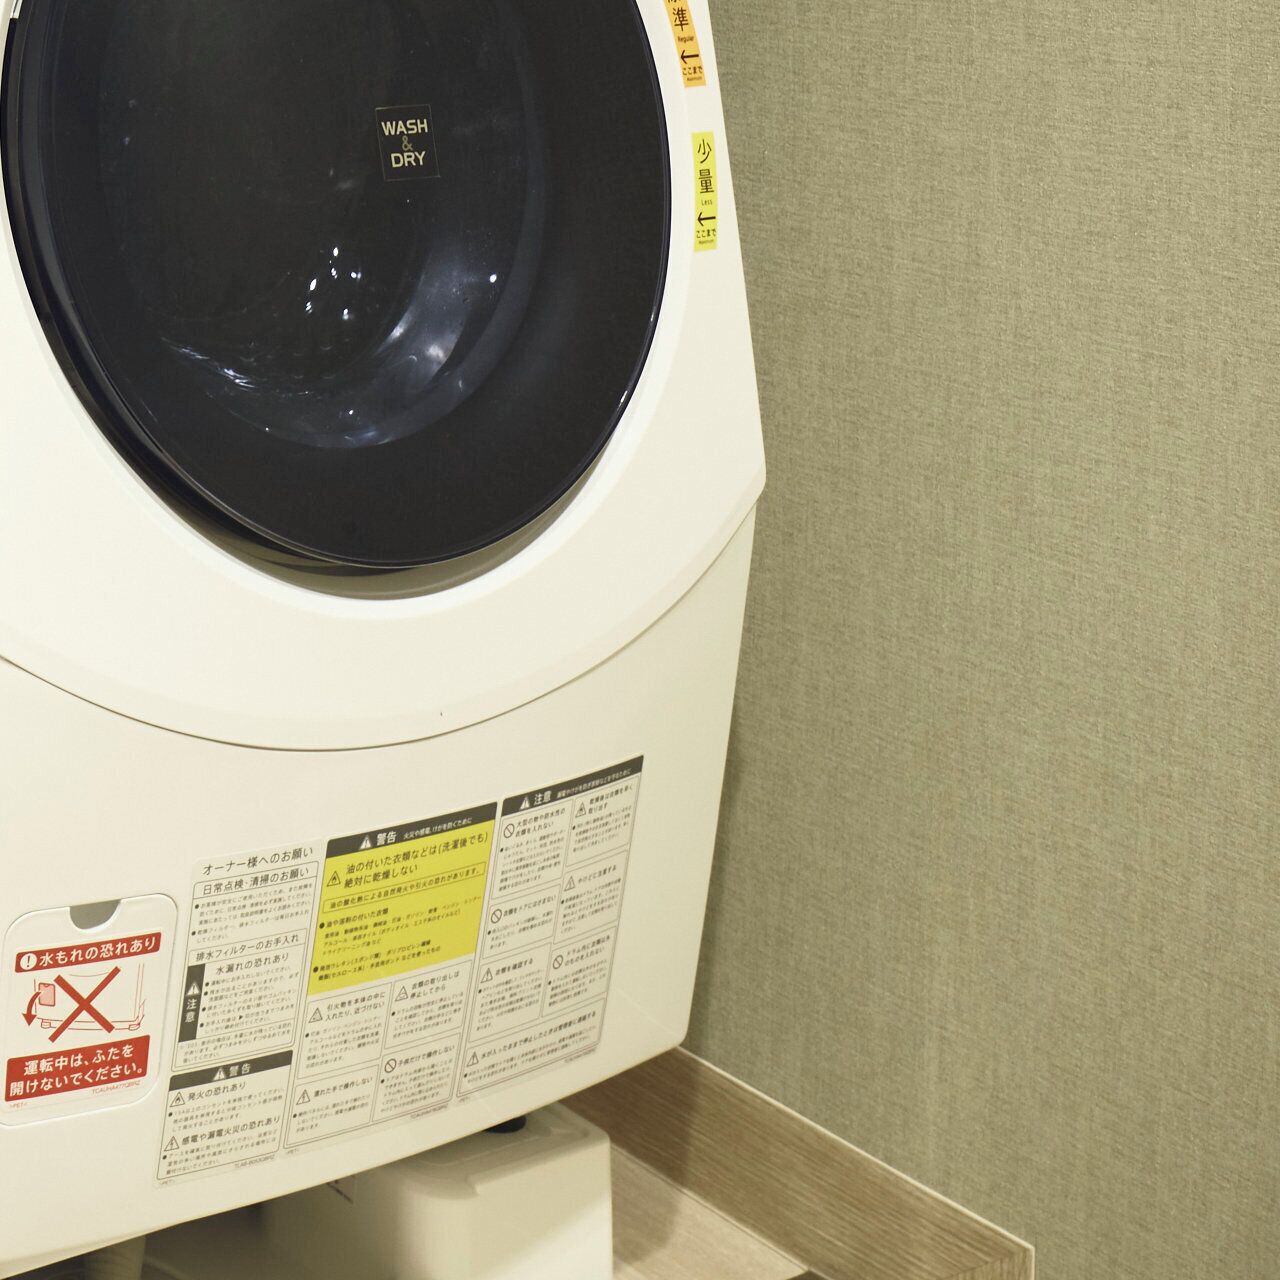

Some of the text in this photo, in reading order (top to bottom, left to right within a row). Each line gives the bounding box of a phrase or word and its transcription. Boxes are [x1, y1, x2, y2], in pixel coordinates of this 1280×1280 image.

[682, 66, 703, 75] ここまで
[381, 119, 428, 136] WASH
[402, 136, 413, 151] &
[391, 151, 426, 167] DRY
[697, 138, 715, 194] 少量
[696, 229, 716, 238] ここまで
[377, 831, 396, 845] 警告
[203, 848, 313, 876] オーナー様へのお願い
[344, 864, 418, 888] 絶対に乾燥しない
[40, 937, 155, 967] 水もれの恐れあり
[196, 935, 299, 962] 排水フィルターのお手入れ
[24, 1045, 133, 1077] 運転中は、ふたを
[230, 1063, 250, 1076] 警告
[10, 1063, 144, 1097] 開けないでください。
